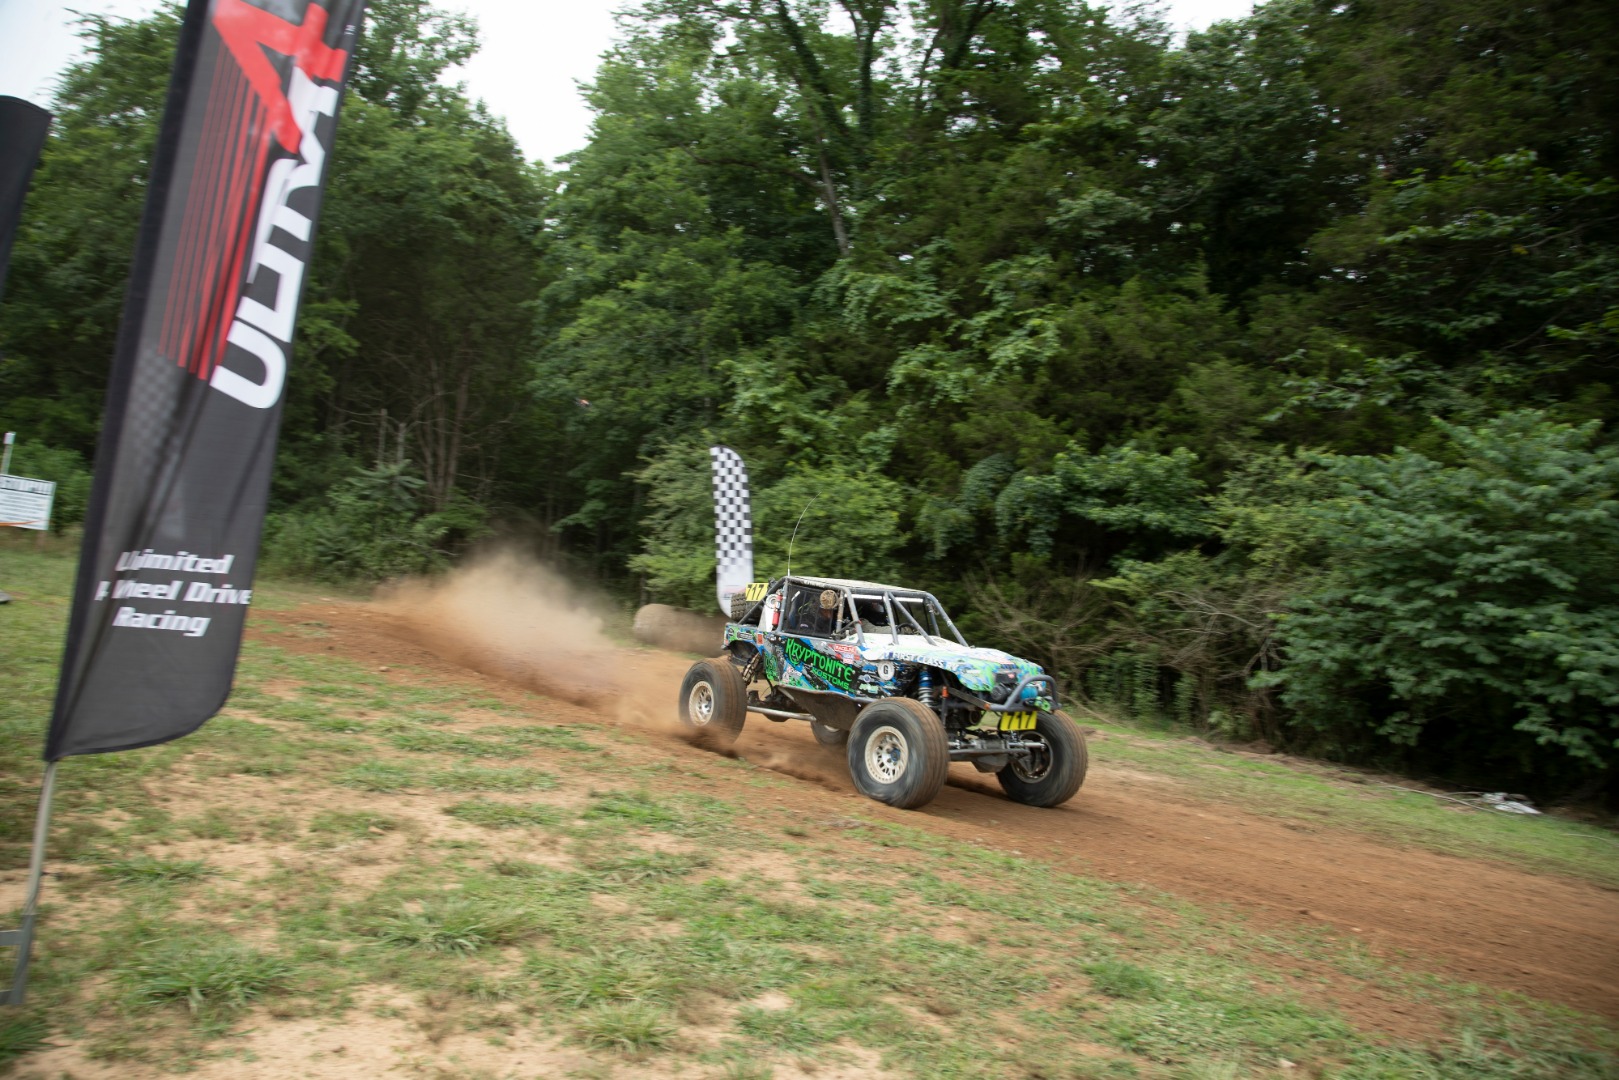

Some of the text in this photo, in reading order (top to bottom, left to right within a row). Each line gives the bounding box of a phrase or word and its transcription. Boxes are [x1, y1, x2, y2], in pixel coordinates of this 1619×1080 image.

[182, 581, 253, 605] Drive
[746, 584, 765, 601] 717
[112, 606, 212, 637] Racing
[786, 638, 855, 682] KRYPTONITE
[883, 664, 889, 675] G
[811, 667, 850, 691] KOSTOMS
[1003, 711, 1034, 730] 717
